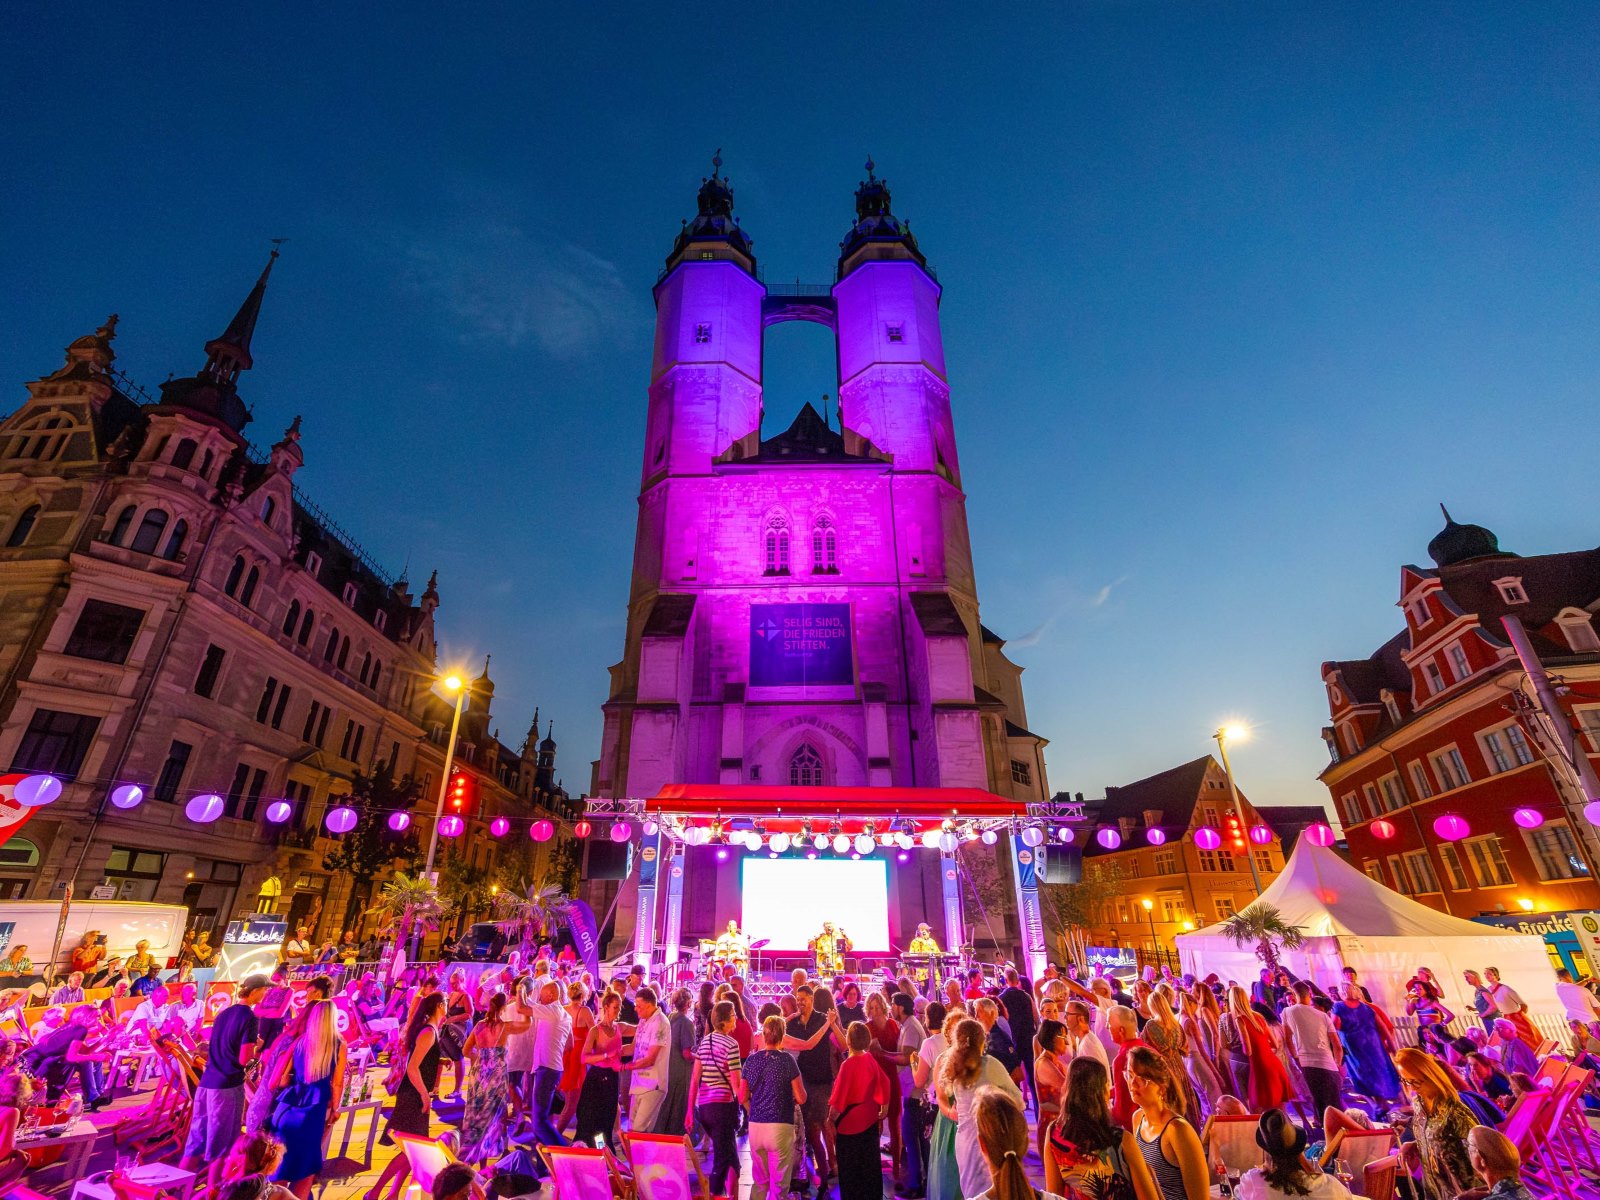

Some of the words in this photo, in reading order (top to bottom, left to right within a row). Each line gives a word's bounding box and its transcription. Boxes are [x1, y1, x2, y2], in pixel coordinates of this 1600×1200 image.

[784, 618, 812, 627] SELIG
[784, 629, 801, 638] DIE
[803, 629, 845, 638] FRIEDEN
[784, 640, 830, 650] STIFTEN.
